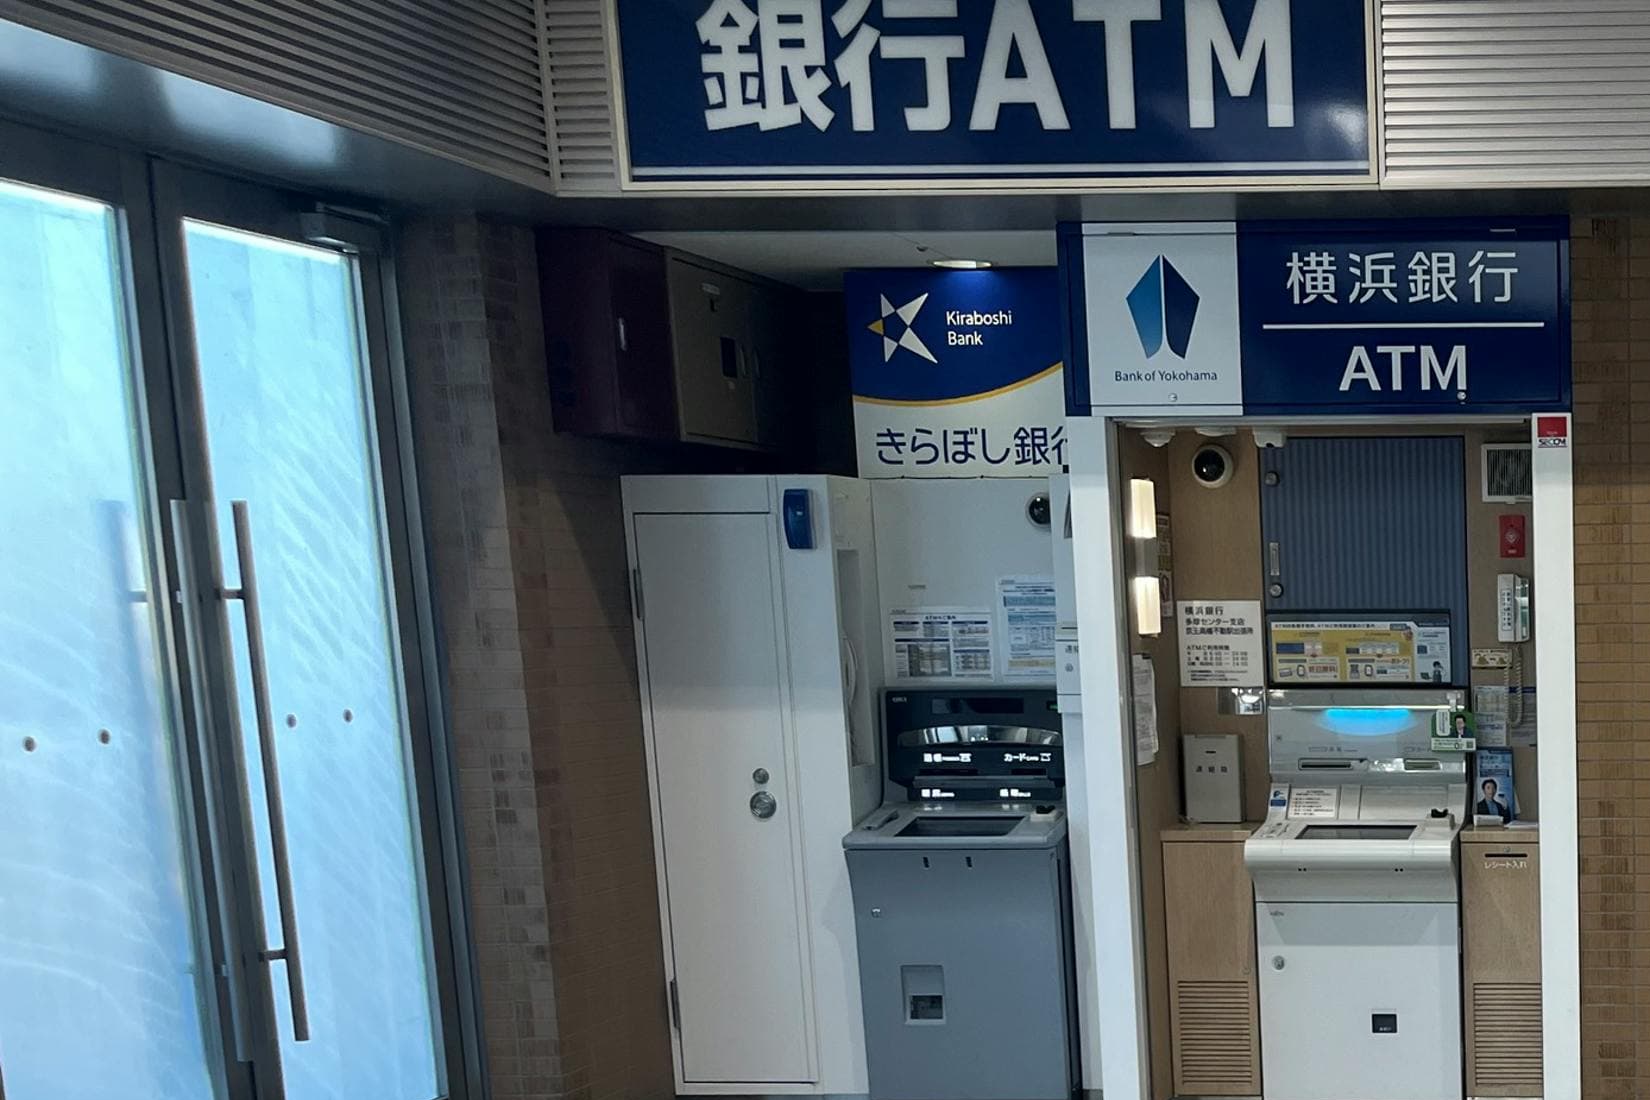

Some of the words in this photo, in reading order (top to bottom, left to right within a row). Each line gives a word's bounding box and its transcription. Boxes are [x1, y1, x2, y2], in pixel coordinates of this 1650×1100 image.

[696, 0, 1295, 132] 銀行ATM
[1286, 250, 1519, 305] 横浜銀行
[945, 310, 1013, 326] Kiraboshi
[947, 331, 984, 346] Bank
[1339, 344, 1468, 391] ATM
[1114, 370, 1143, 382] Bank
[1144, 370, 1156, 382] of
[1156, 370, 1218, 382] Yokohama
[1184, 606, 1224, 616] 横浜銀行
